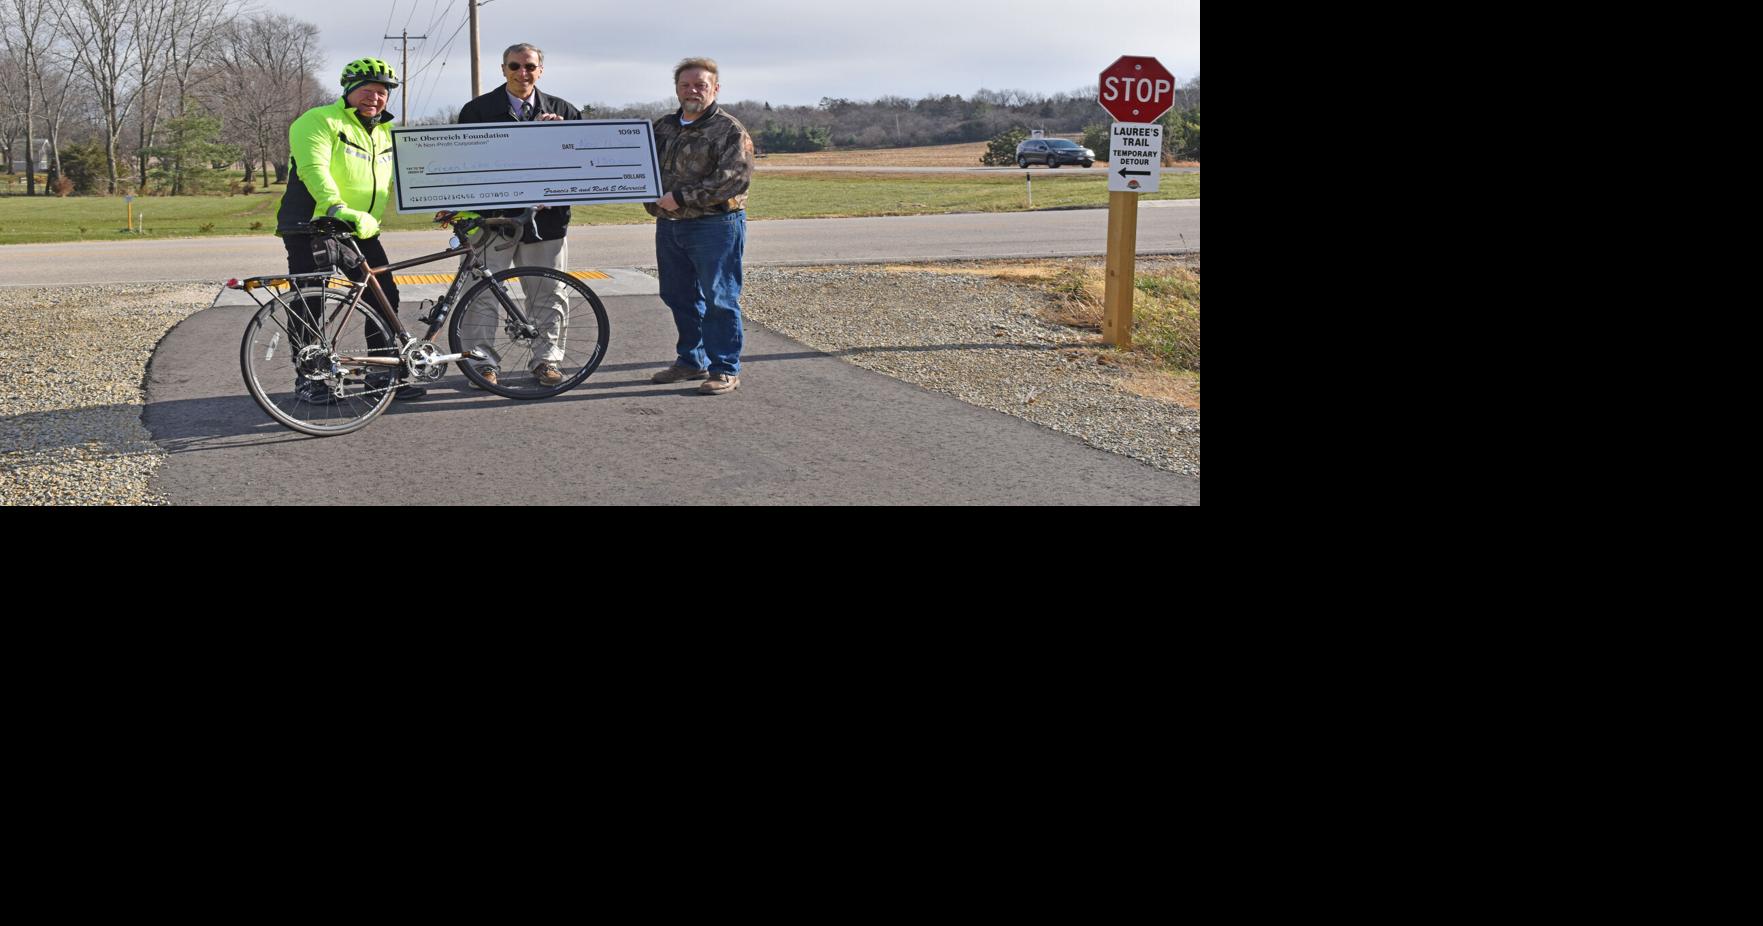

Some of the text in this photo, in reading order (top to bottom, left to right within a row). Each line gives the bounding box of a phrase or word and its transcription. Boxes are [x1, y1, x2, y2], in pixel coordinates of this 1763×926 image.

[1103, 76, 1171, 103] STOP
[1114, 127, 1159, 137] LAUREE'S
[420, 134, 460, 142] Oberreich
[1122, 138, 1150, 147] TRAIL
[1113, 149, 1158, 158] TEMPORARY
[1120, 158, 1149, 166] DETOUR
